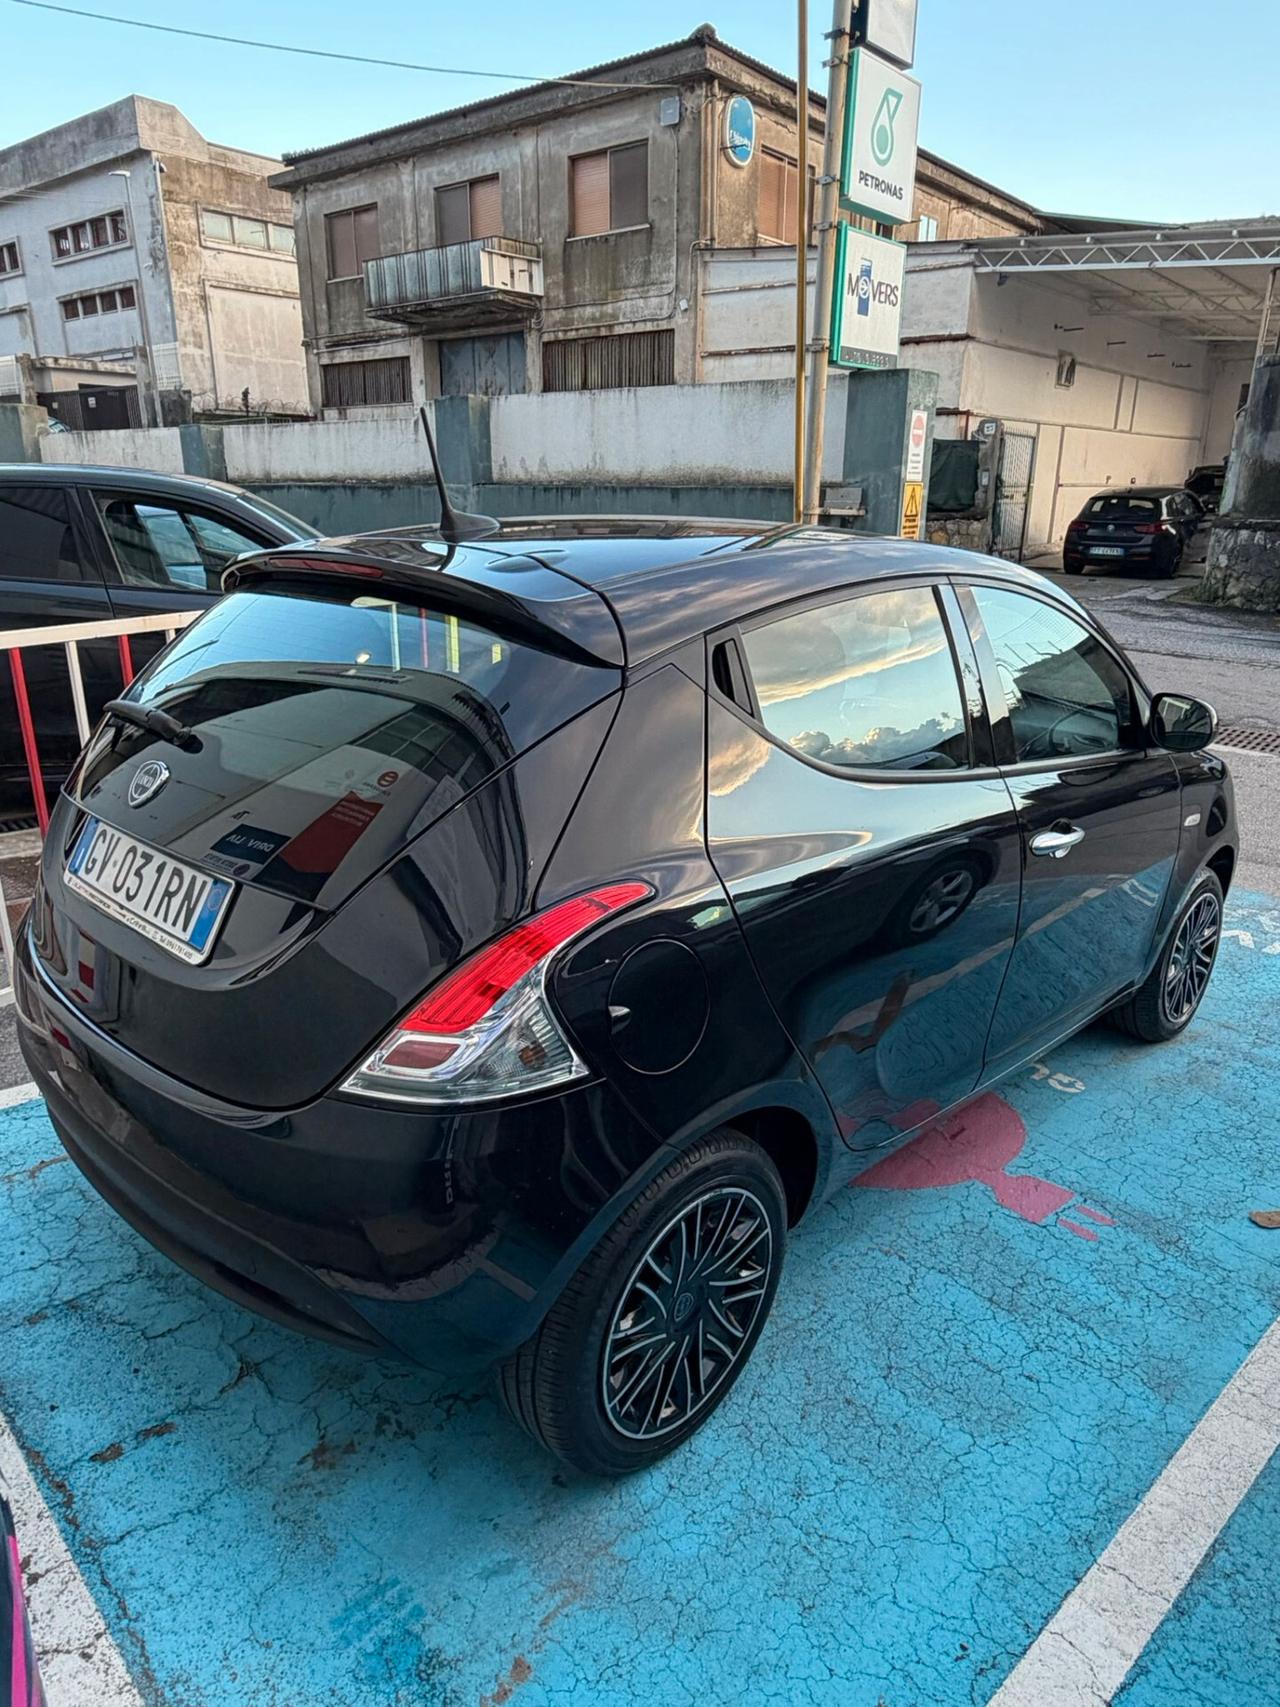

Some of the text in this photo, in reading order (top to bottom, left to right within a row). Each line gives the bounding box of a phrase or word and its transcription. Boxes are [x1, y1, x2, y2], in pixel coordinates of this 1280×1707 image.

[858, 169, 904, 201] PETRONAS
[84, 828, 122, 883] GV
[112, 845, 208, 933] 031RN
